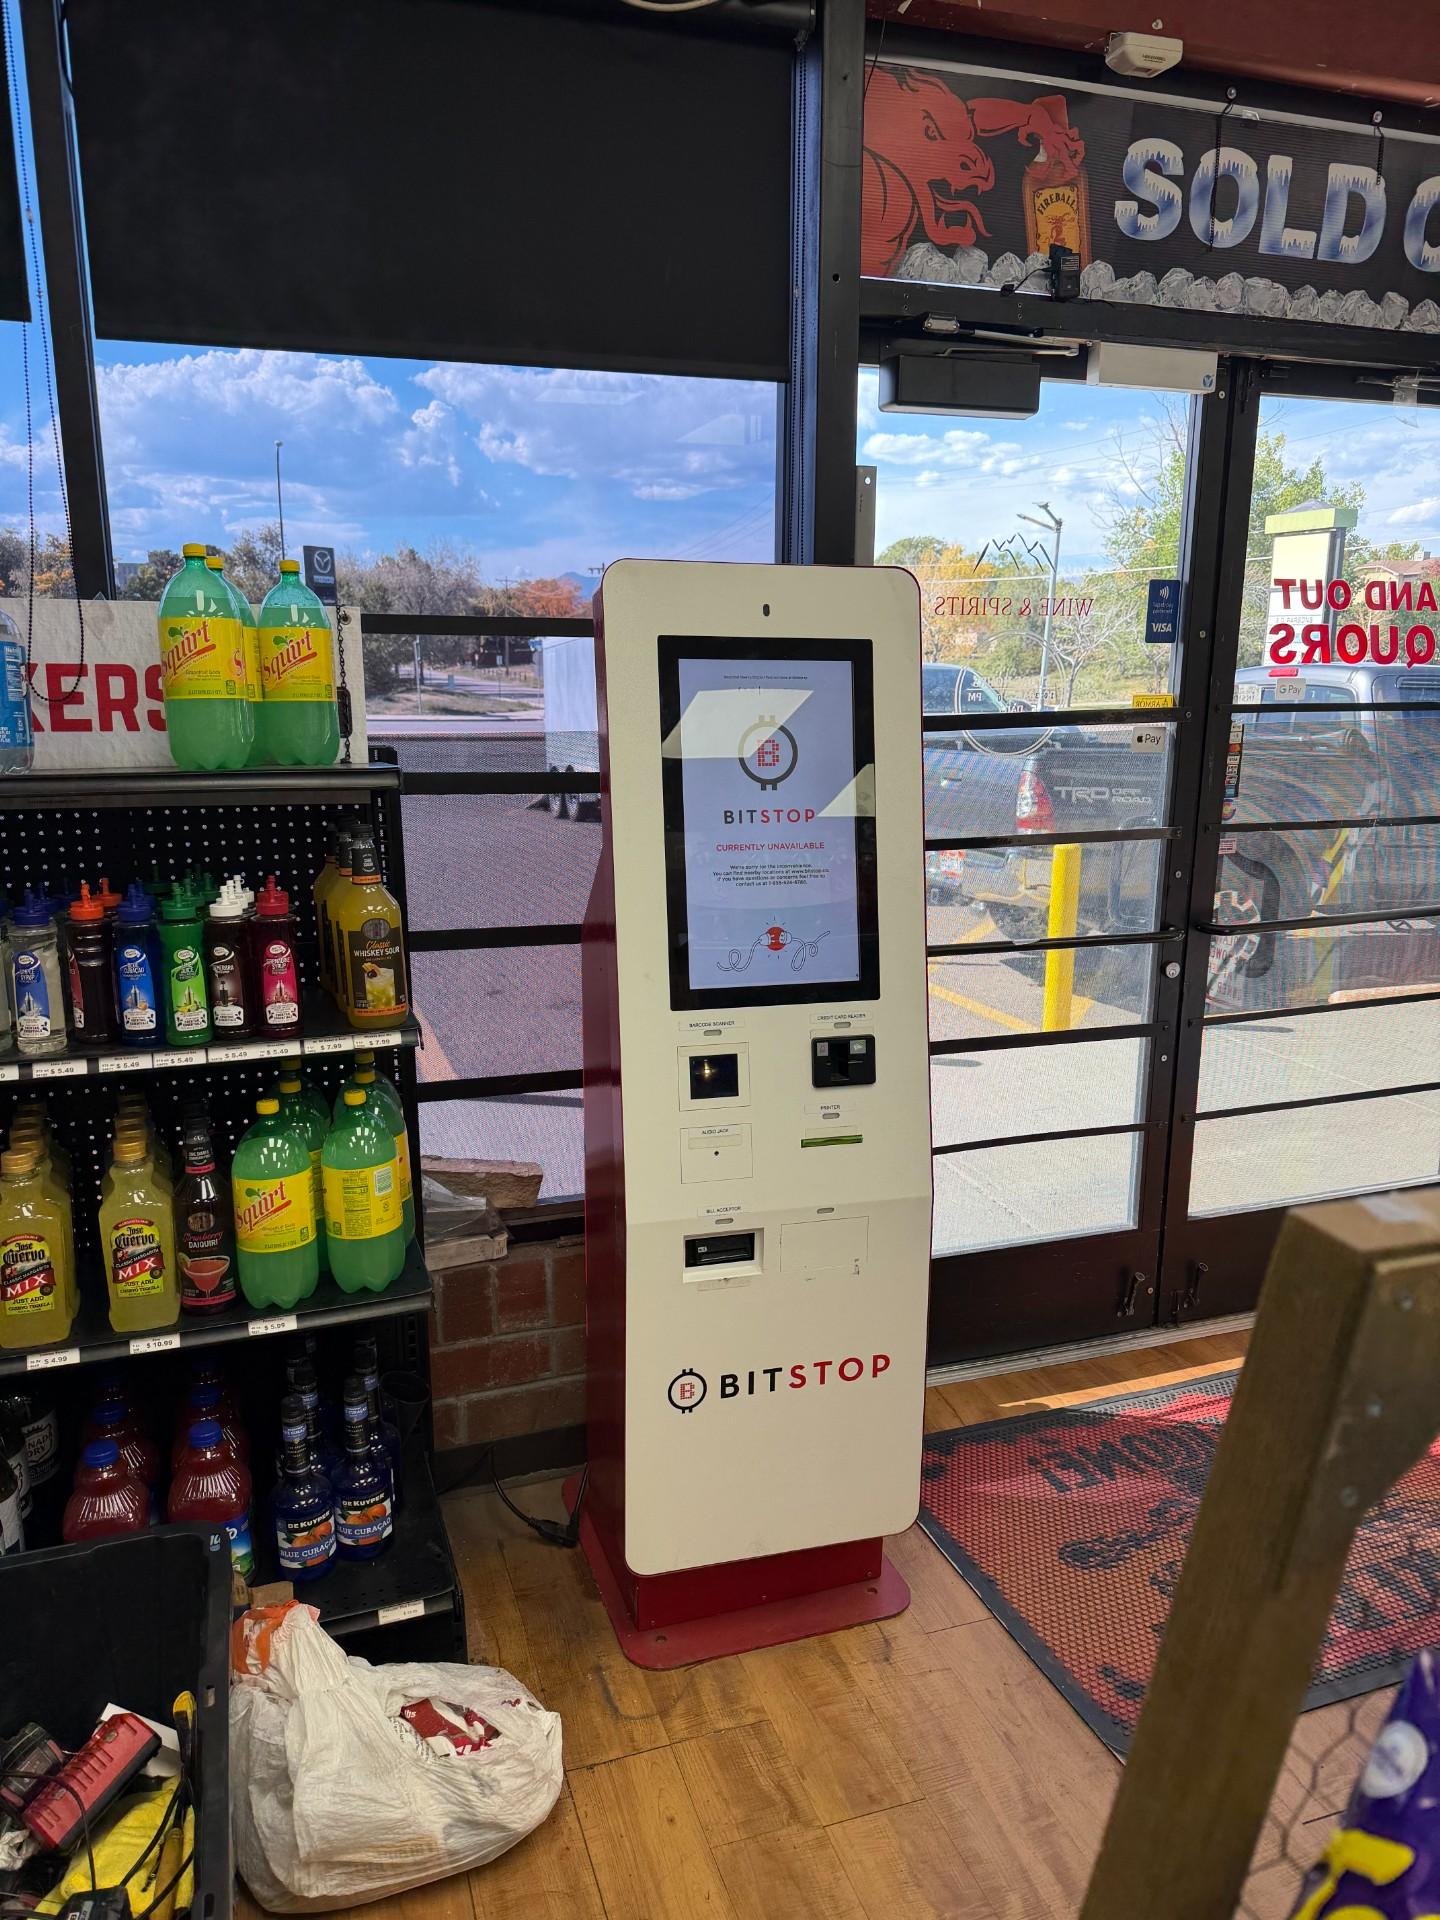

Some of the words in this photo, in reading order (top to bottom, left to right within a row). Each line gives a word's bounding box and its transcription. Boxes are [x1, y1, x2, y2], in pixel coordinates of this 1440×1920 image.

[1037, 192, 1077, 215] FIREBALL
[1114, 137, 1387, 264] SOLD
[1151, 623, 1172, 632] VISA
[161, 621, 211, 676] Squirt
[1269, 623, 1436, 669] QUORS
[262, 630, 313, 682] Squirt
[1279, 685, 1287, 694] G
[1288, 684, 1301, 696] Pay
[1144, 733, 1161, 745] Pay
[1053, 786, 1110, 803] TRD
[723, 808, 815, 824] BITSTOP
[716, 843, 765, 852] CURRENTLY
[767, 841, 825, 850] UNAVAILABLE
[354, 949, 383, 957] WHISKEY
[385, 946, 400, 955] SOUR
[366, 940, 391, 949] Classic
[236, 1181, 287, 1232] Squirt
[127, 1227, 143, 1236] Jose
[183, 1231, 224, 1243] Strawberry
[15, 1243, 33, 1252] Jose
[115, 1233, 155, 1248] Cuervo
[188, 1239, 218, 1248] DAIQUIRI
[3, 1249, 45, 1265] Cuervo
[116, 1259, 133, 1268] CLASSIC
[134, 1248, 159, 1261] MARGARITA
[118, 1257, 157, 1280] MIX
[6, 1273, 48, 1297] MIX
[51, 1356, 67, 1364] 4.99
[720, 1354, 891, 1399] BITSTOP
[353, 1493, 384, 1506] KUYPER
[300, 1510, 330, 1527] KUYPER
[355, 1517, 391, 1535] CURAÇAO
[280, 1549, 299, 1557] BLUE
[302, 1533, 336, 1557] CURAÇAO
